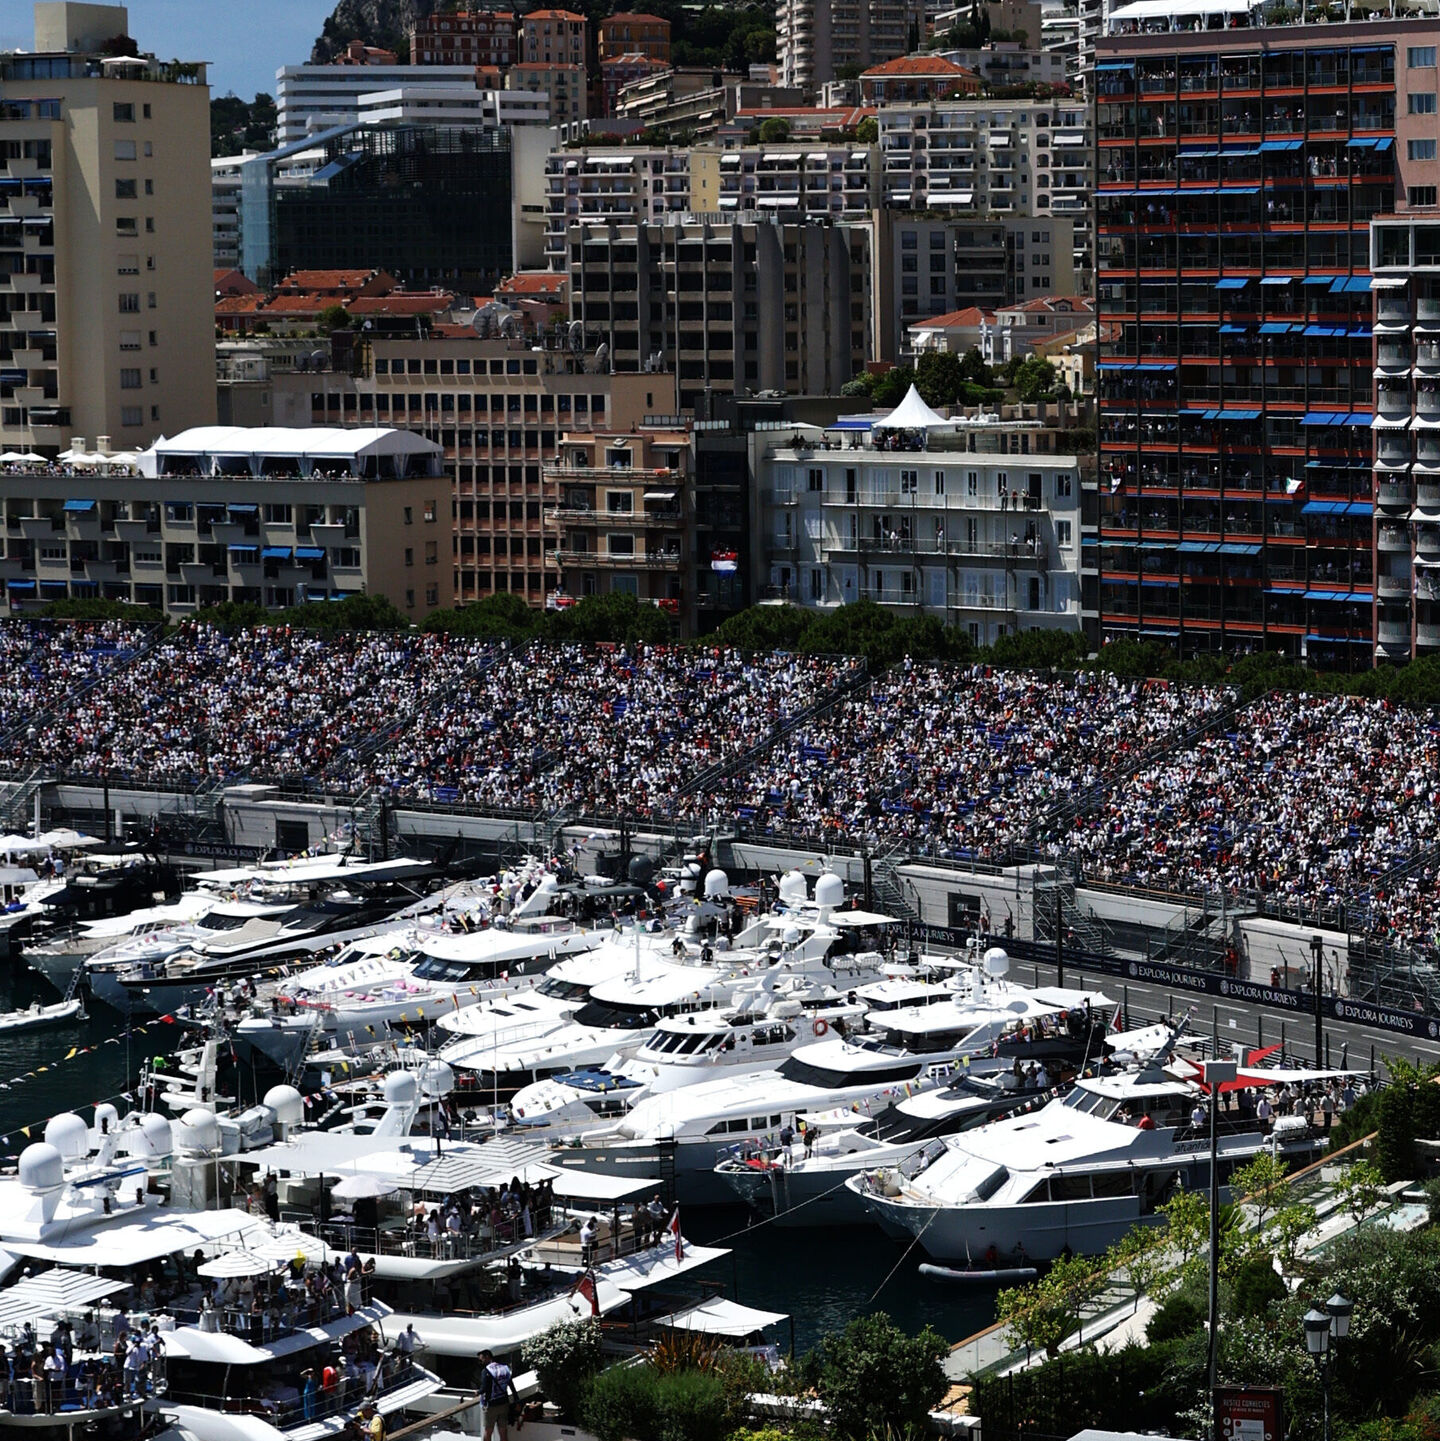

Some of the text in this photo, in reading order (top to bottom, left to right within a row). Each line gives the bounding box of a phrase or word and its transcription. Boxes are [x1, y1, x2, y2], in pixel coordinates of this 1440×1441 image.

[919, 928, 955, 942] JOURNEYS
[1138, 966, 1206, 989] EXPLORA JOURNEYS
[1230, 983, 1298, 1007] EXPLORA JOURNEYS
[1344, 1005, 1414, 1030] EXPLORA JOURNEYS
